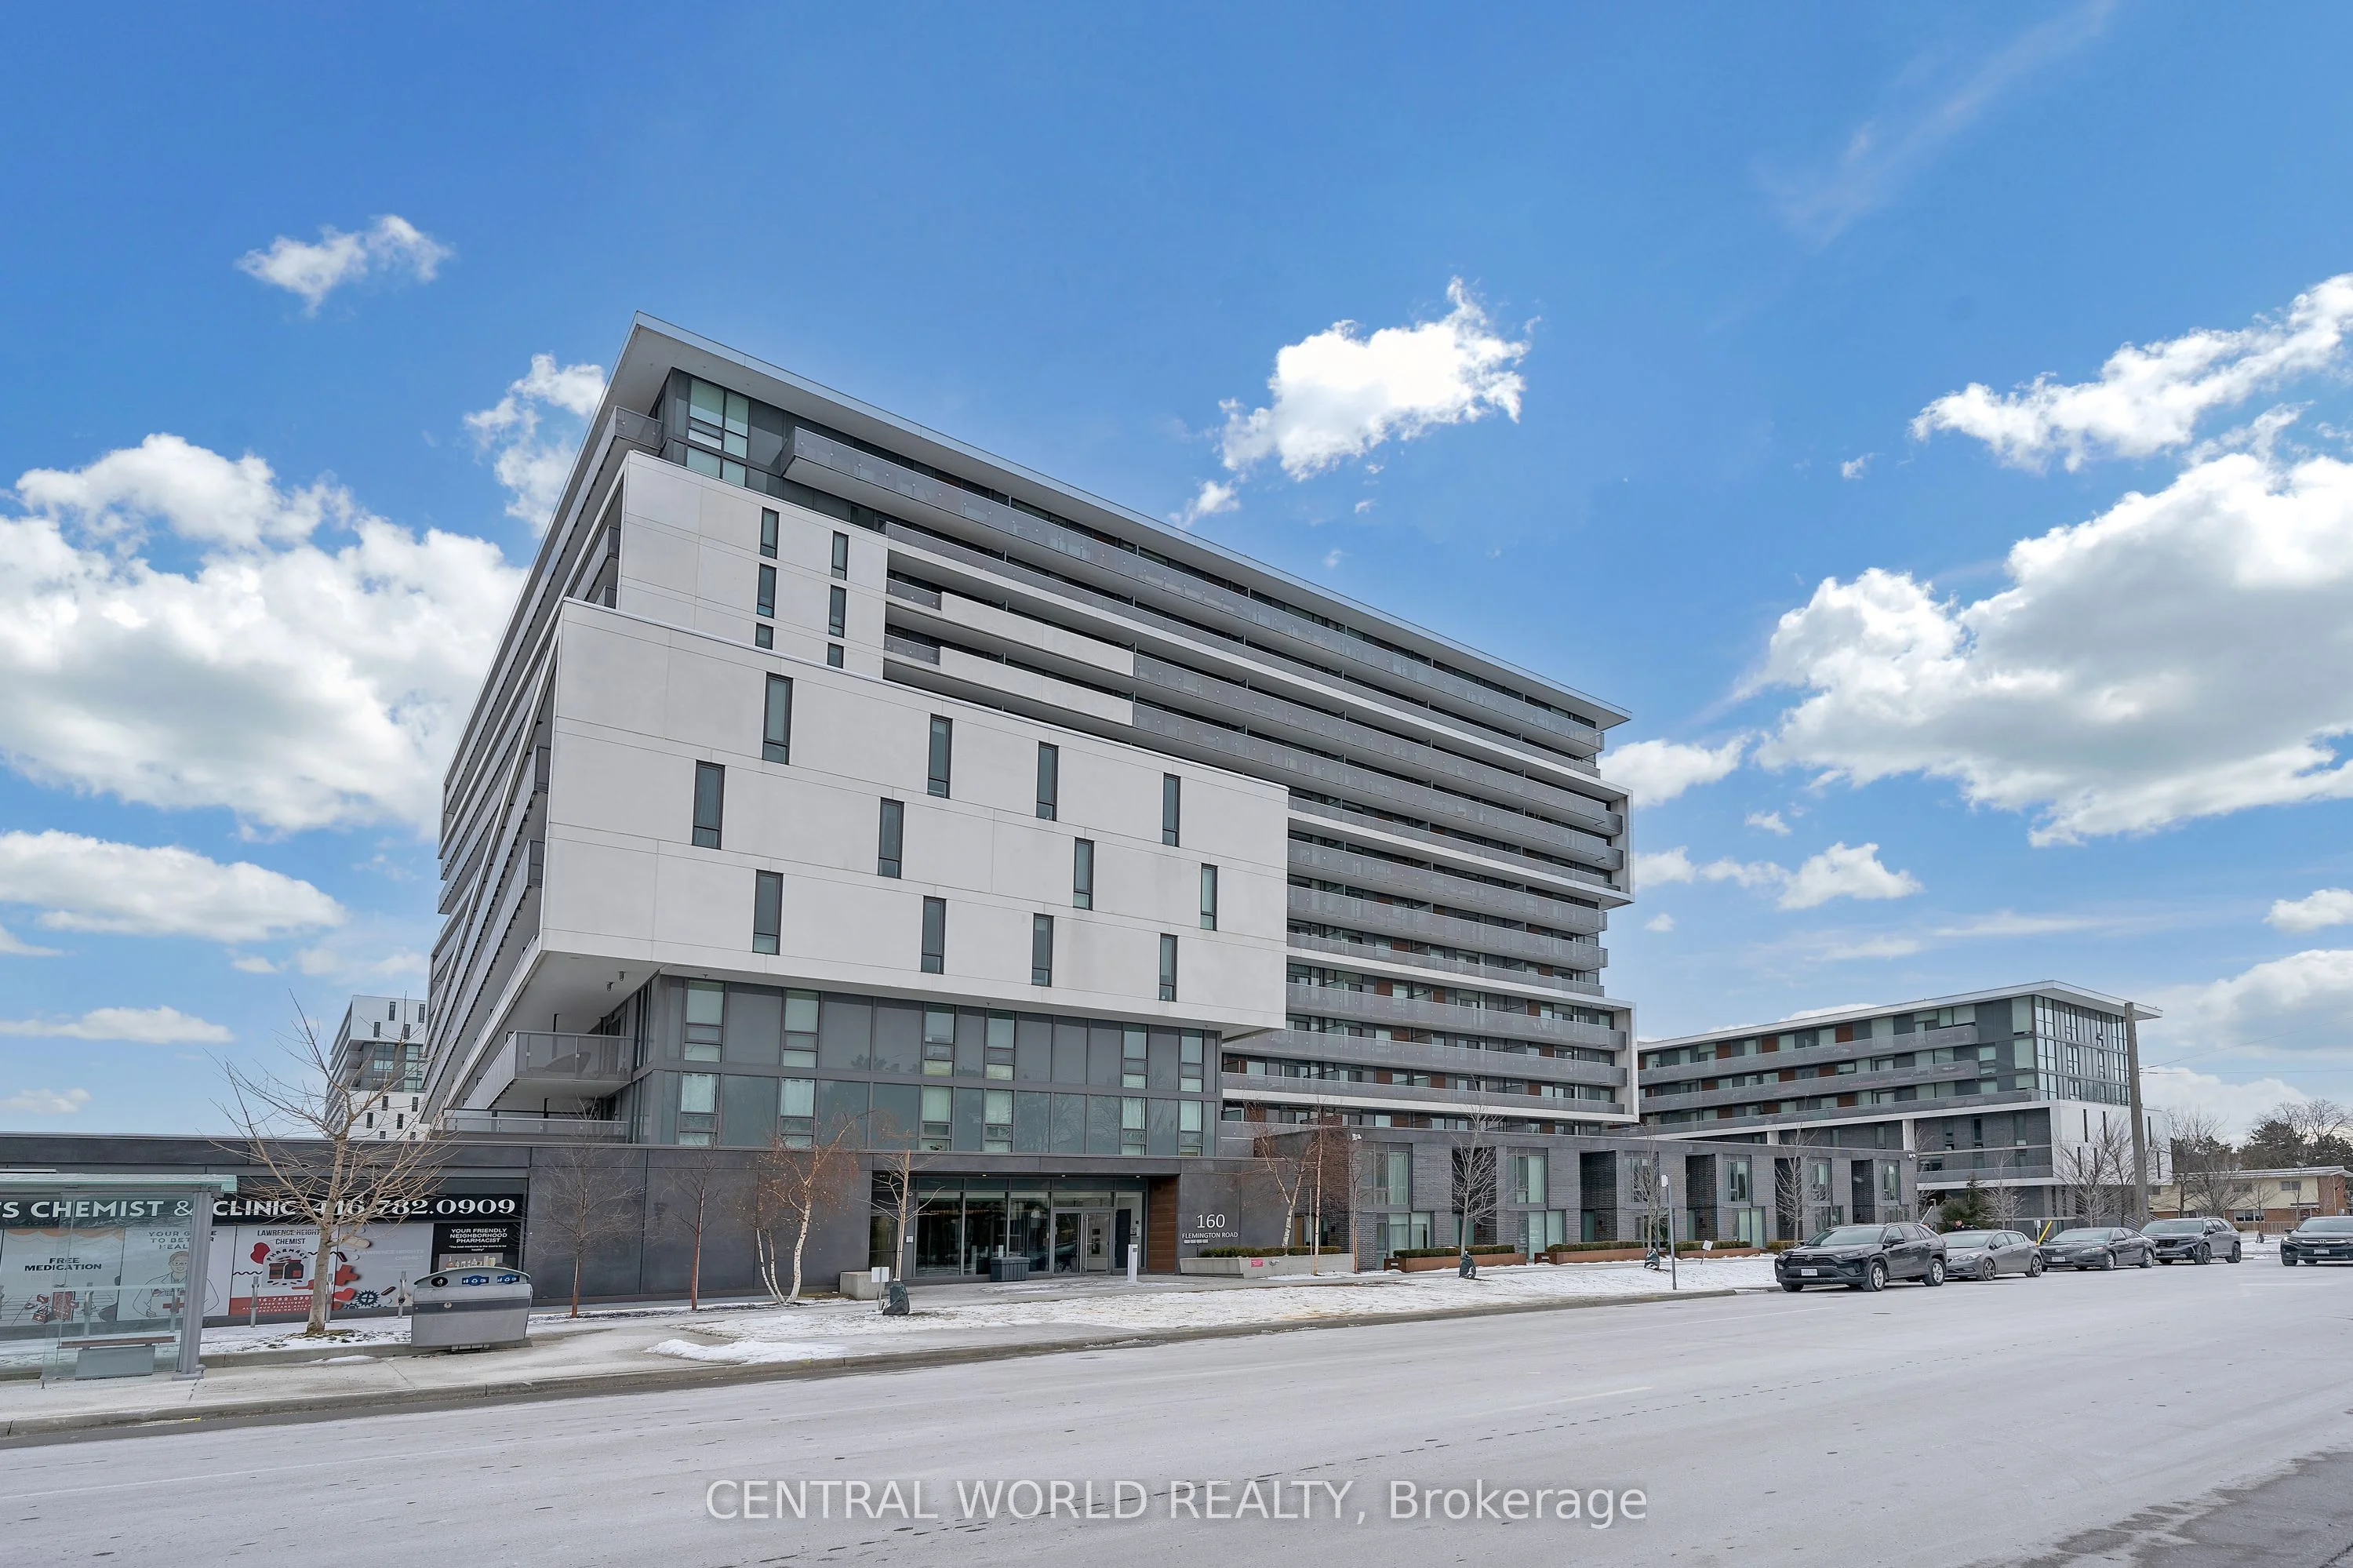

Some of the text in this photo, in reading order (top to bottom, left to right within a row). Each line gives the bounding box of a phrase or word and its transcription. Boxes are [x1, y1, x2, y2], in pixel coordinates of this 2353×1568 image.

[0, 1199, 515, 1218] S CHEMIST & CLINIC 416782.0909
[1197, 1213, 1225, 1228] 160
[267, 1248, 308, 1261] PHARMACY
